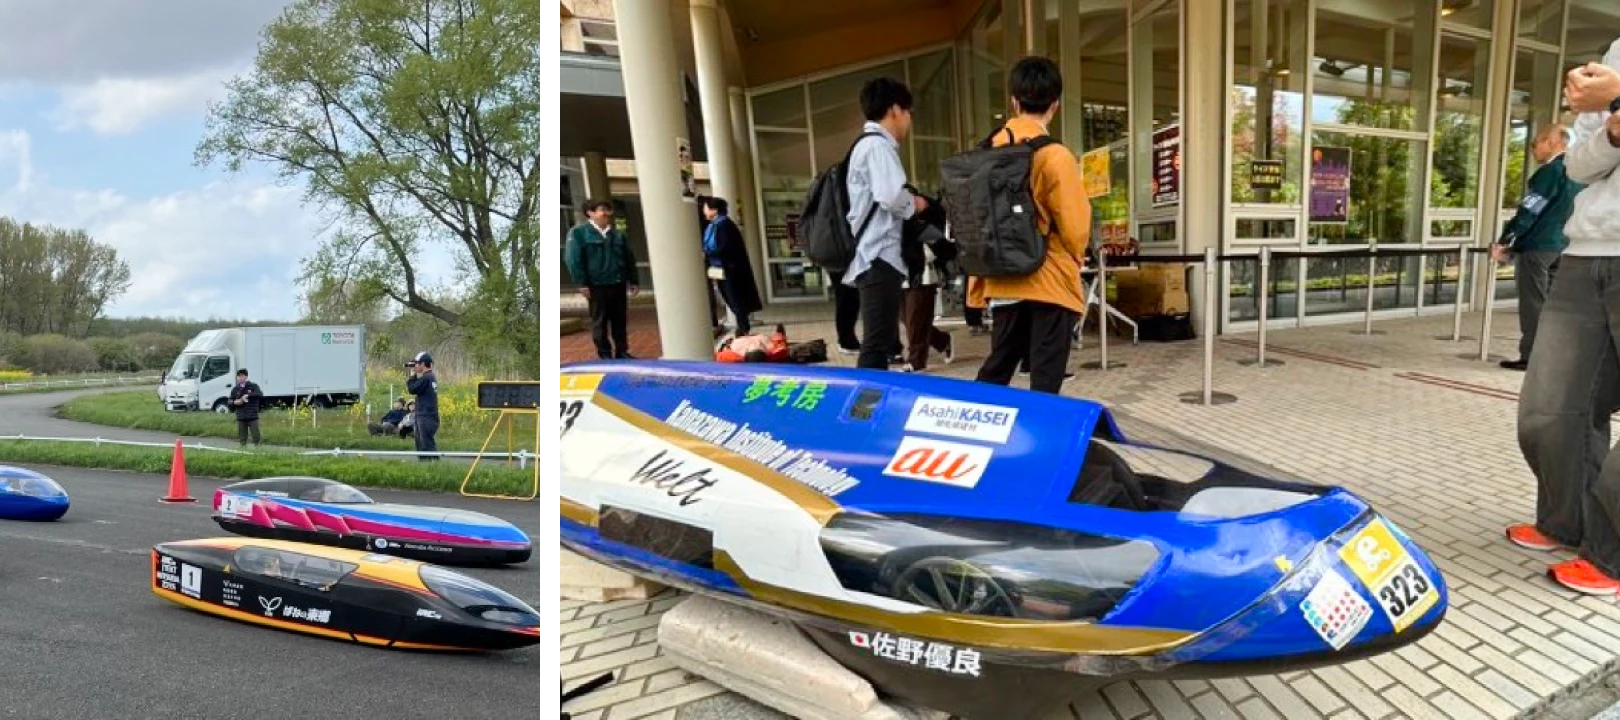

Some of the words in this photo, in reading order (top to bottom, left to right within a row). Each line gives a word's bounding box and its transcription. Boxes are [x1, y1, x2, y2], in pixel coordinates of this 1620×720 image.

[629, 448, 719, 507] Welt
[891, 447, 979, 480] au
[188, 570, 195, 586] 1
[1380, 563, 1429, 617] 323
[871, 631, 982, 677] 佐野優良
